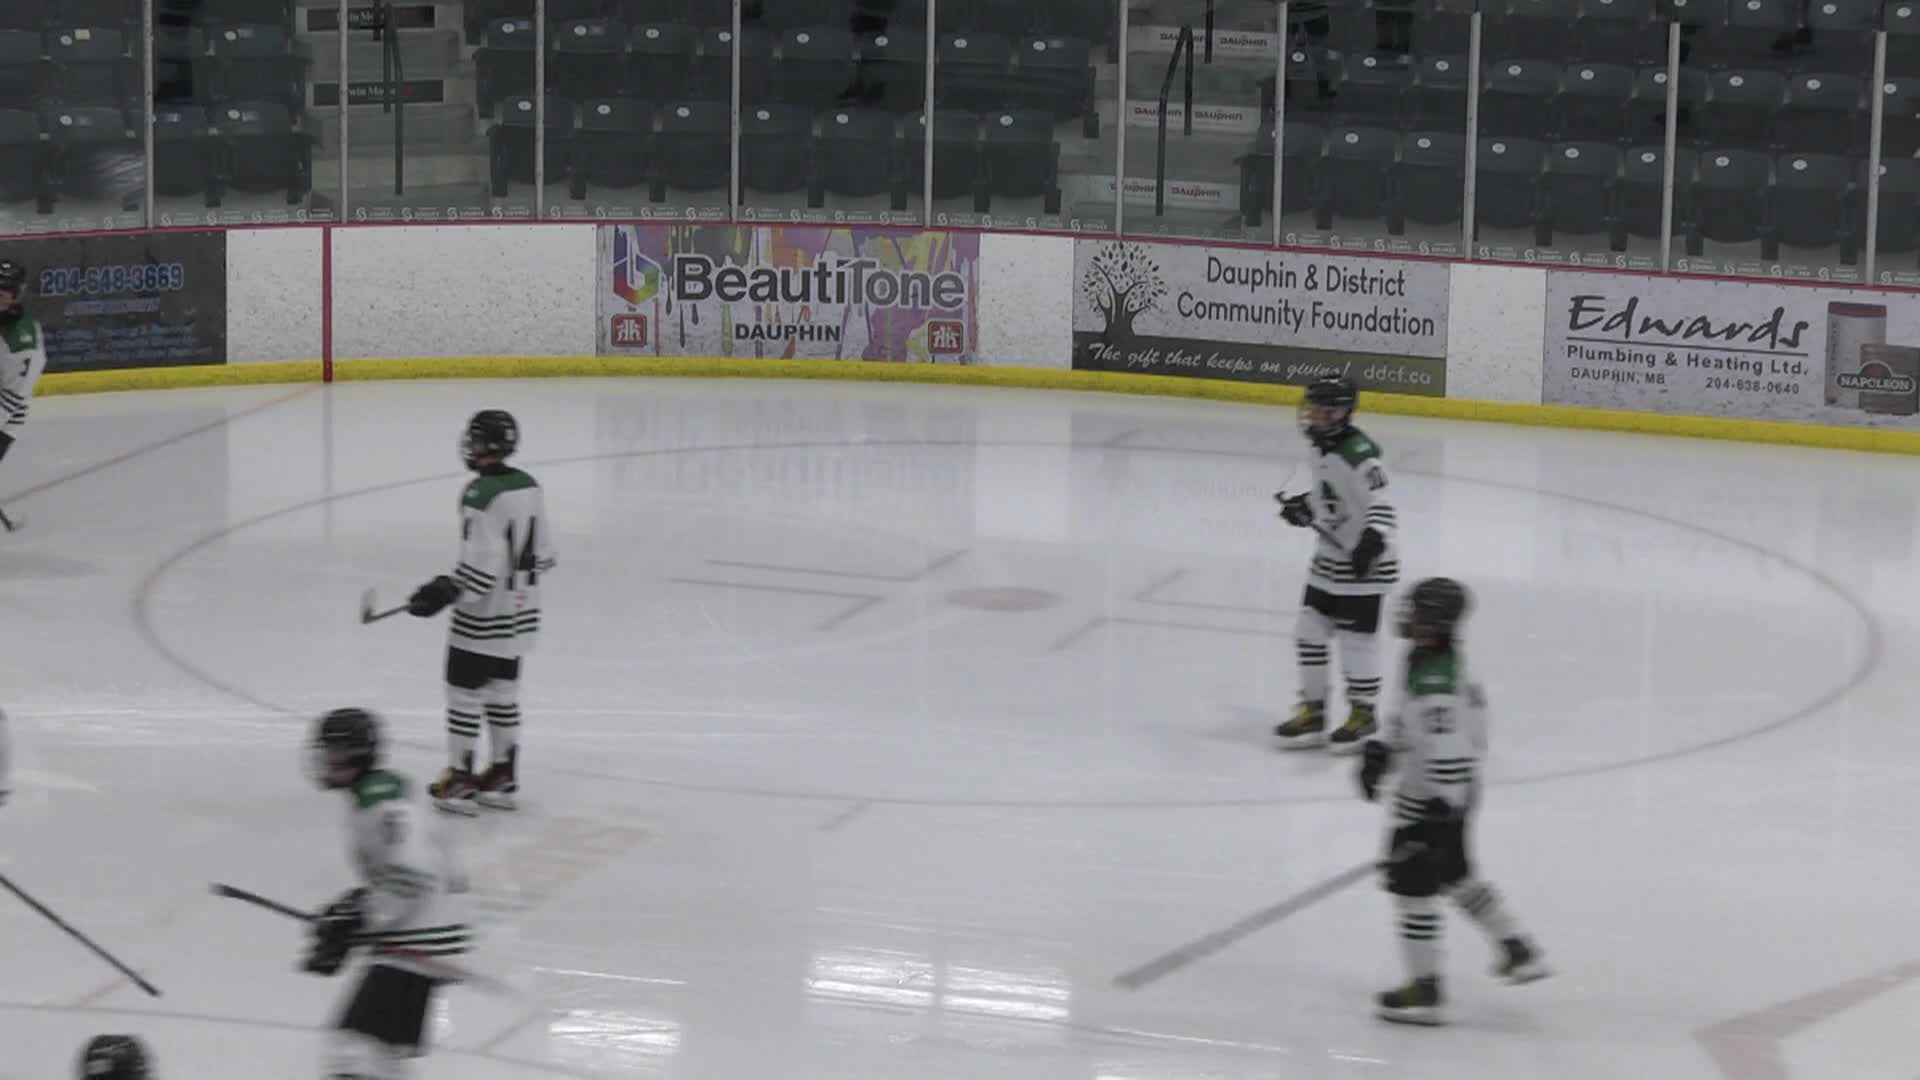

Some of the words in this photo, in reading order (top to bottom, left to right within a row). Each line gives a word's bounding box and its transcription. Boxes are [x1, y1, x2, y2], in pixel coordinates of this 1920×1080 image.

[675, 256, 965, 307] BeautiTone
[1206, 256, 1297, 294] Dauphin
[1304, 264, 1319, 291] &
[1326, 265, 1405, 297] District
[1177, 291, 1304, 333] Community
[1312, 301, 1434, 336] Foundation
[1568, 295, 1809, 350] Edwards
[735, 323, 841, 343] DAUPHIN
[1088, 342, 1121, 361] The
[1128, 348, 1160, 368] gift
[1165, 350, 1202, 367] that
[1206, 352, 1253, 374] keeps
[1260, 362, 1281, 373] on
[1567, 345, 1656, 368] Plumbing
[1665, 351, 1678, 366] &
[1687, 353, 1763, 376] Heating
[1363, 365, 1432, 385] ddcf.ca
[1645, 372, 1665, 385] MB
[1705, 377, 1800, 395] 204-638-0640
[1841, 376, 1909, 390] NAPOLEON
[504, 515, 538, 591] 14
